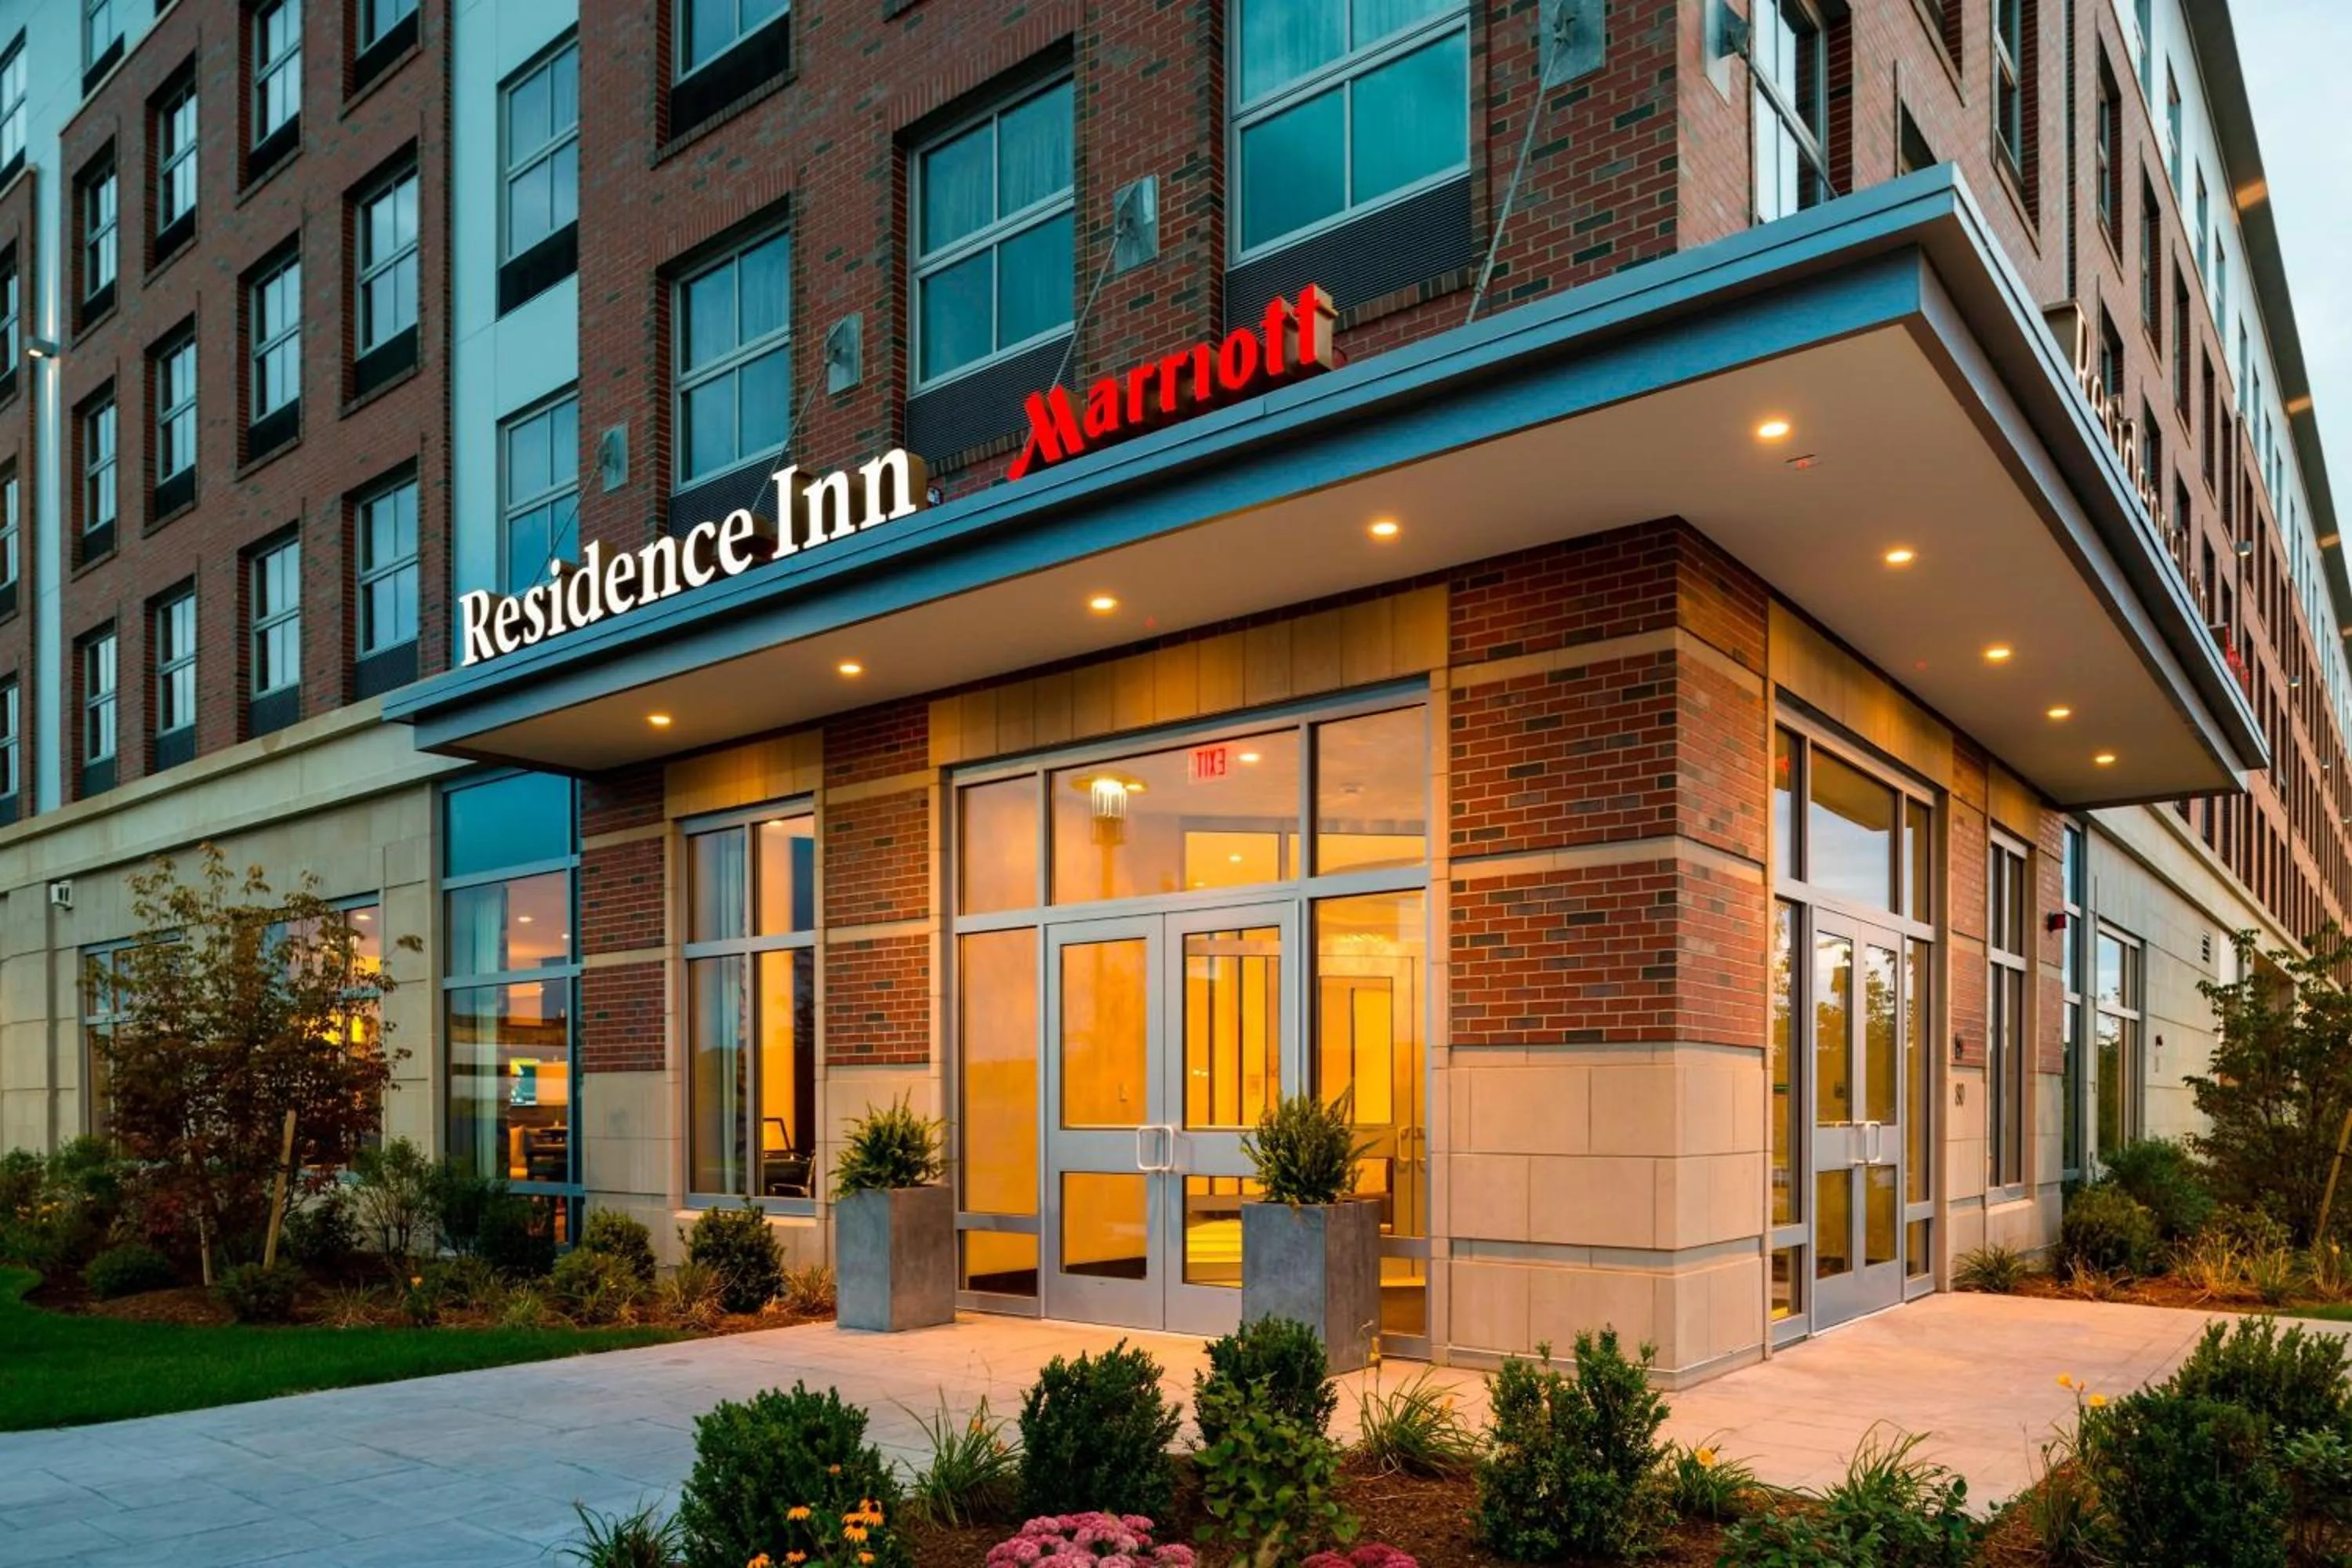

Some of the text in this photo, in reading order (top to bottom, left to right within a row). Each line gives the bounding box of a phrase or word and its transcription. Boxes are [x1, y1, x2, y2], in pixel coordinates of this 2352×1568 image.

[1007, 282, 1322, 481] Marriott
[459, 448, 916, 666] Residence Inn
